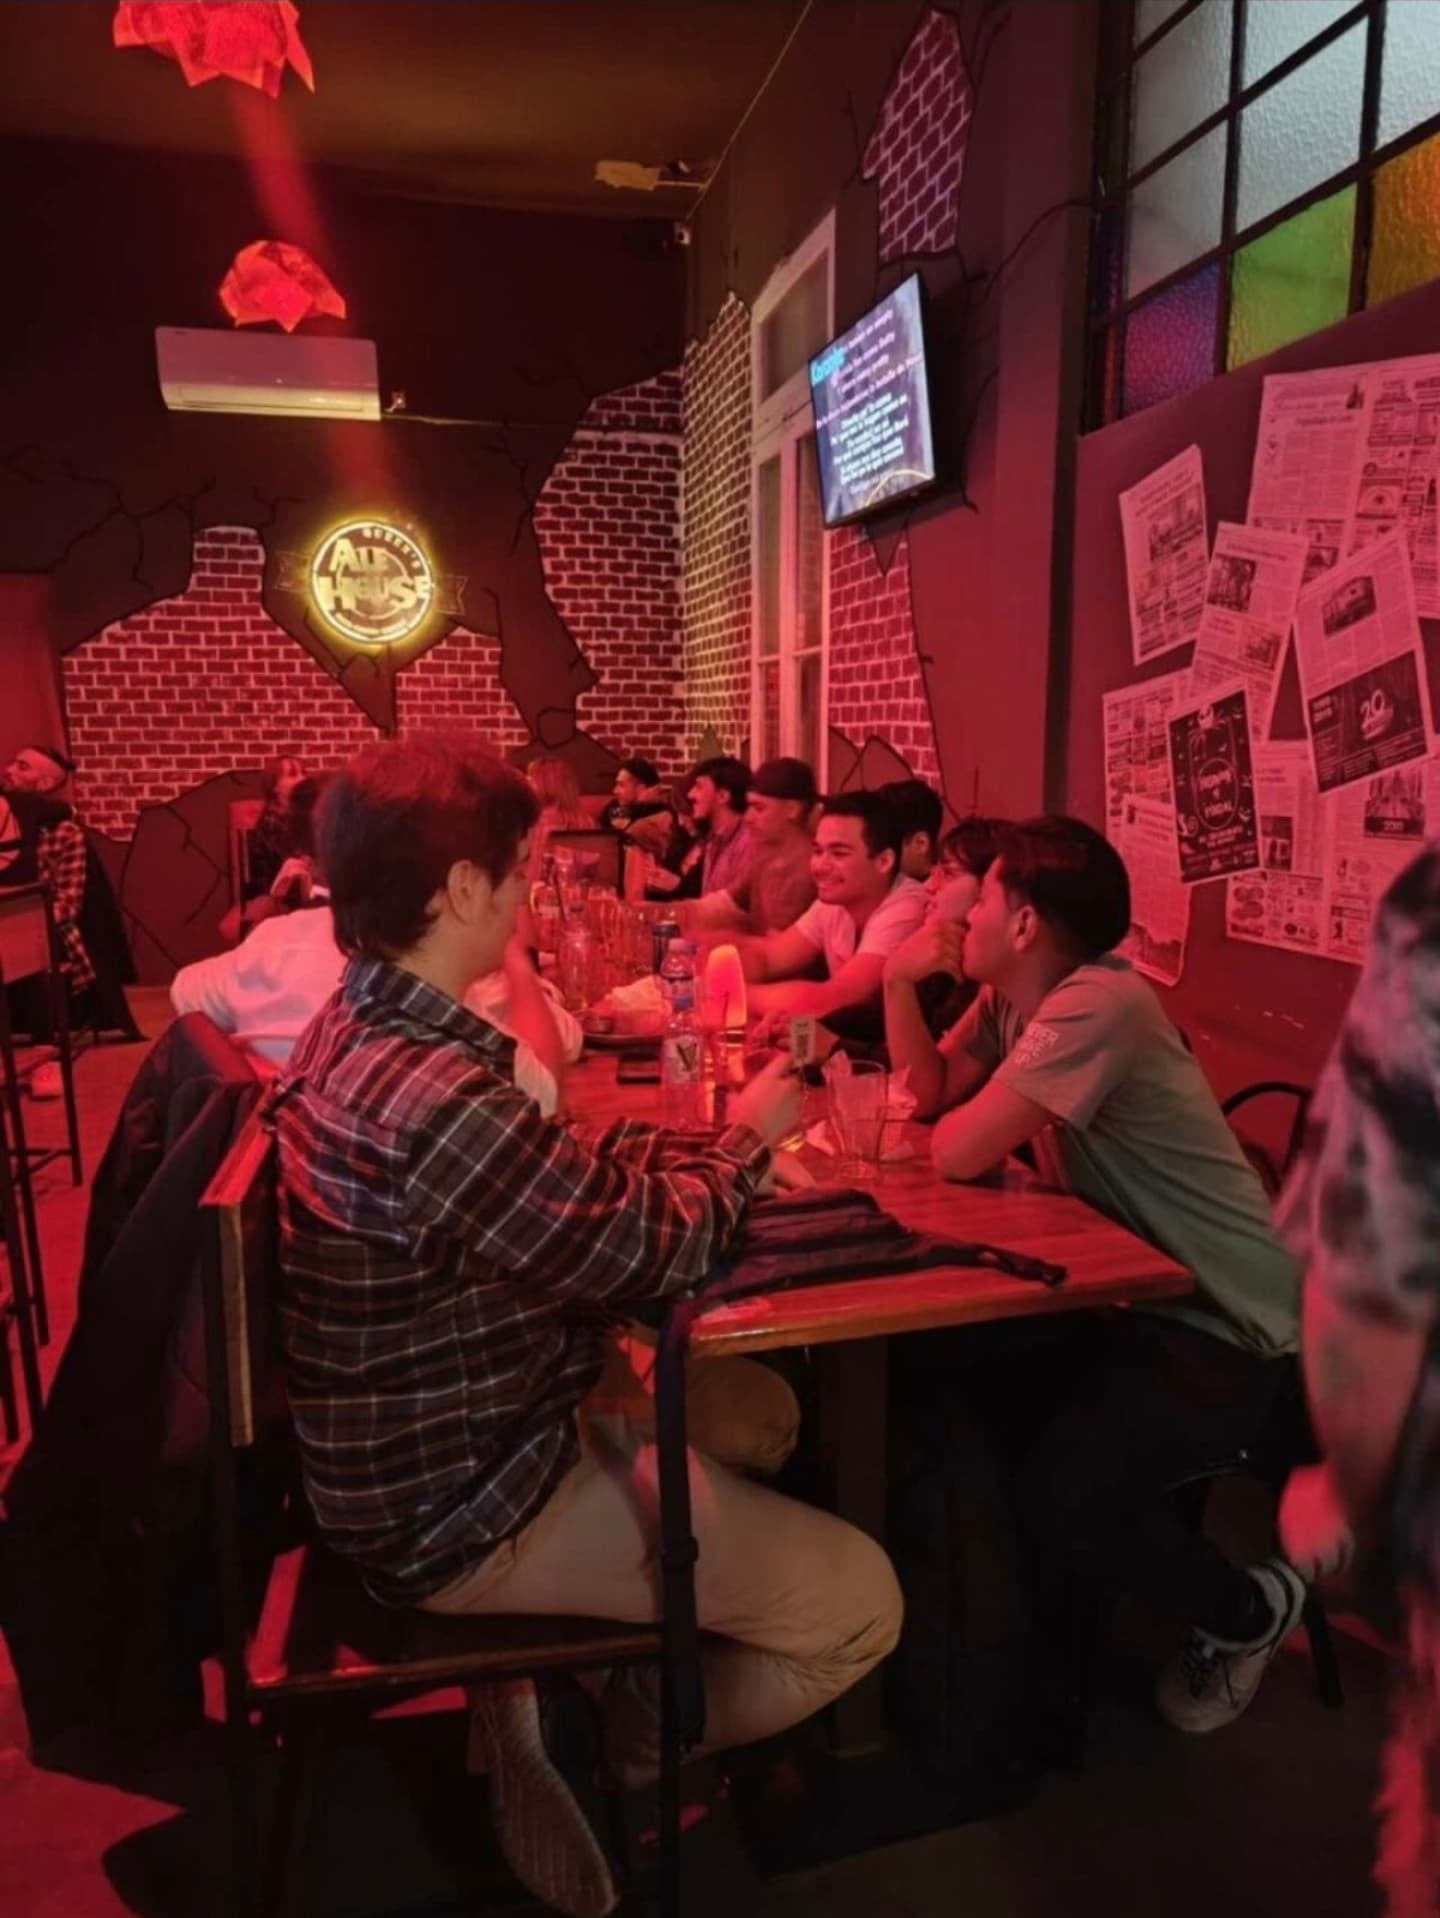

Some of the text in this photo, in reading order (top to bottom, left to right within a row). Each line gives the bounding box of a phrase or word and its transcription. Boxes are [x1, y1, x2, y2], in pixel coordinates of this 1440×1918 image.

[329, 538, 389, 572] ALE
[318, 575, 433, 611] HOUSE
[1360, 688, 1385, 729] 20
